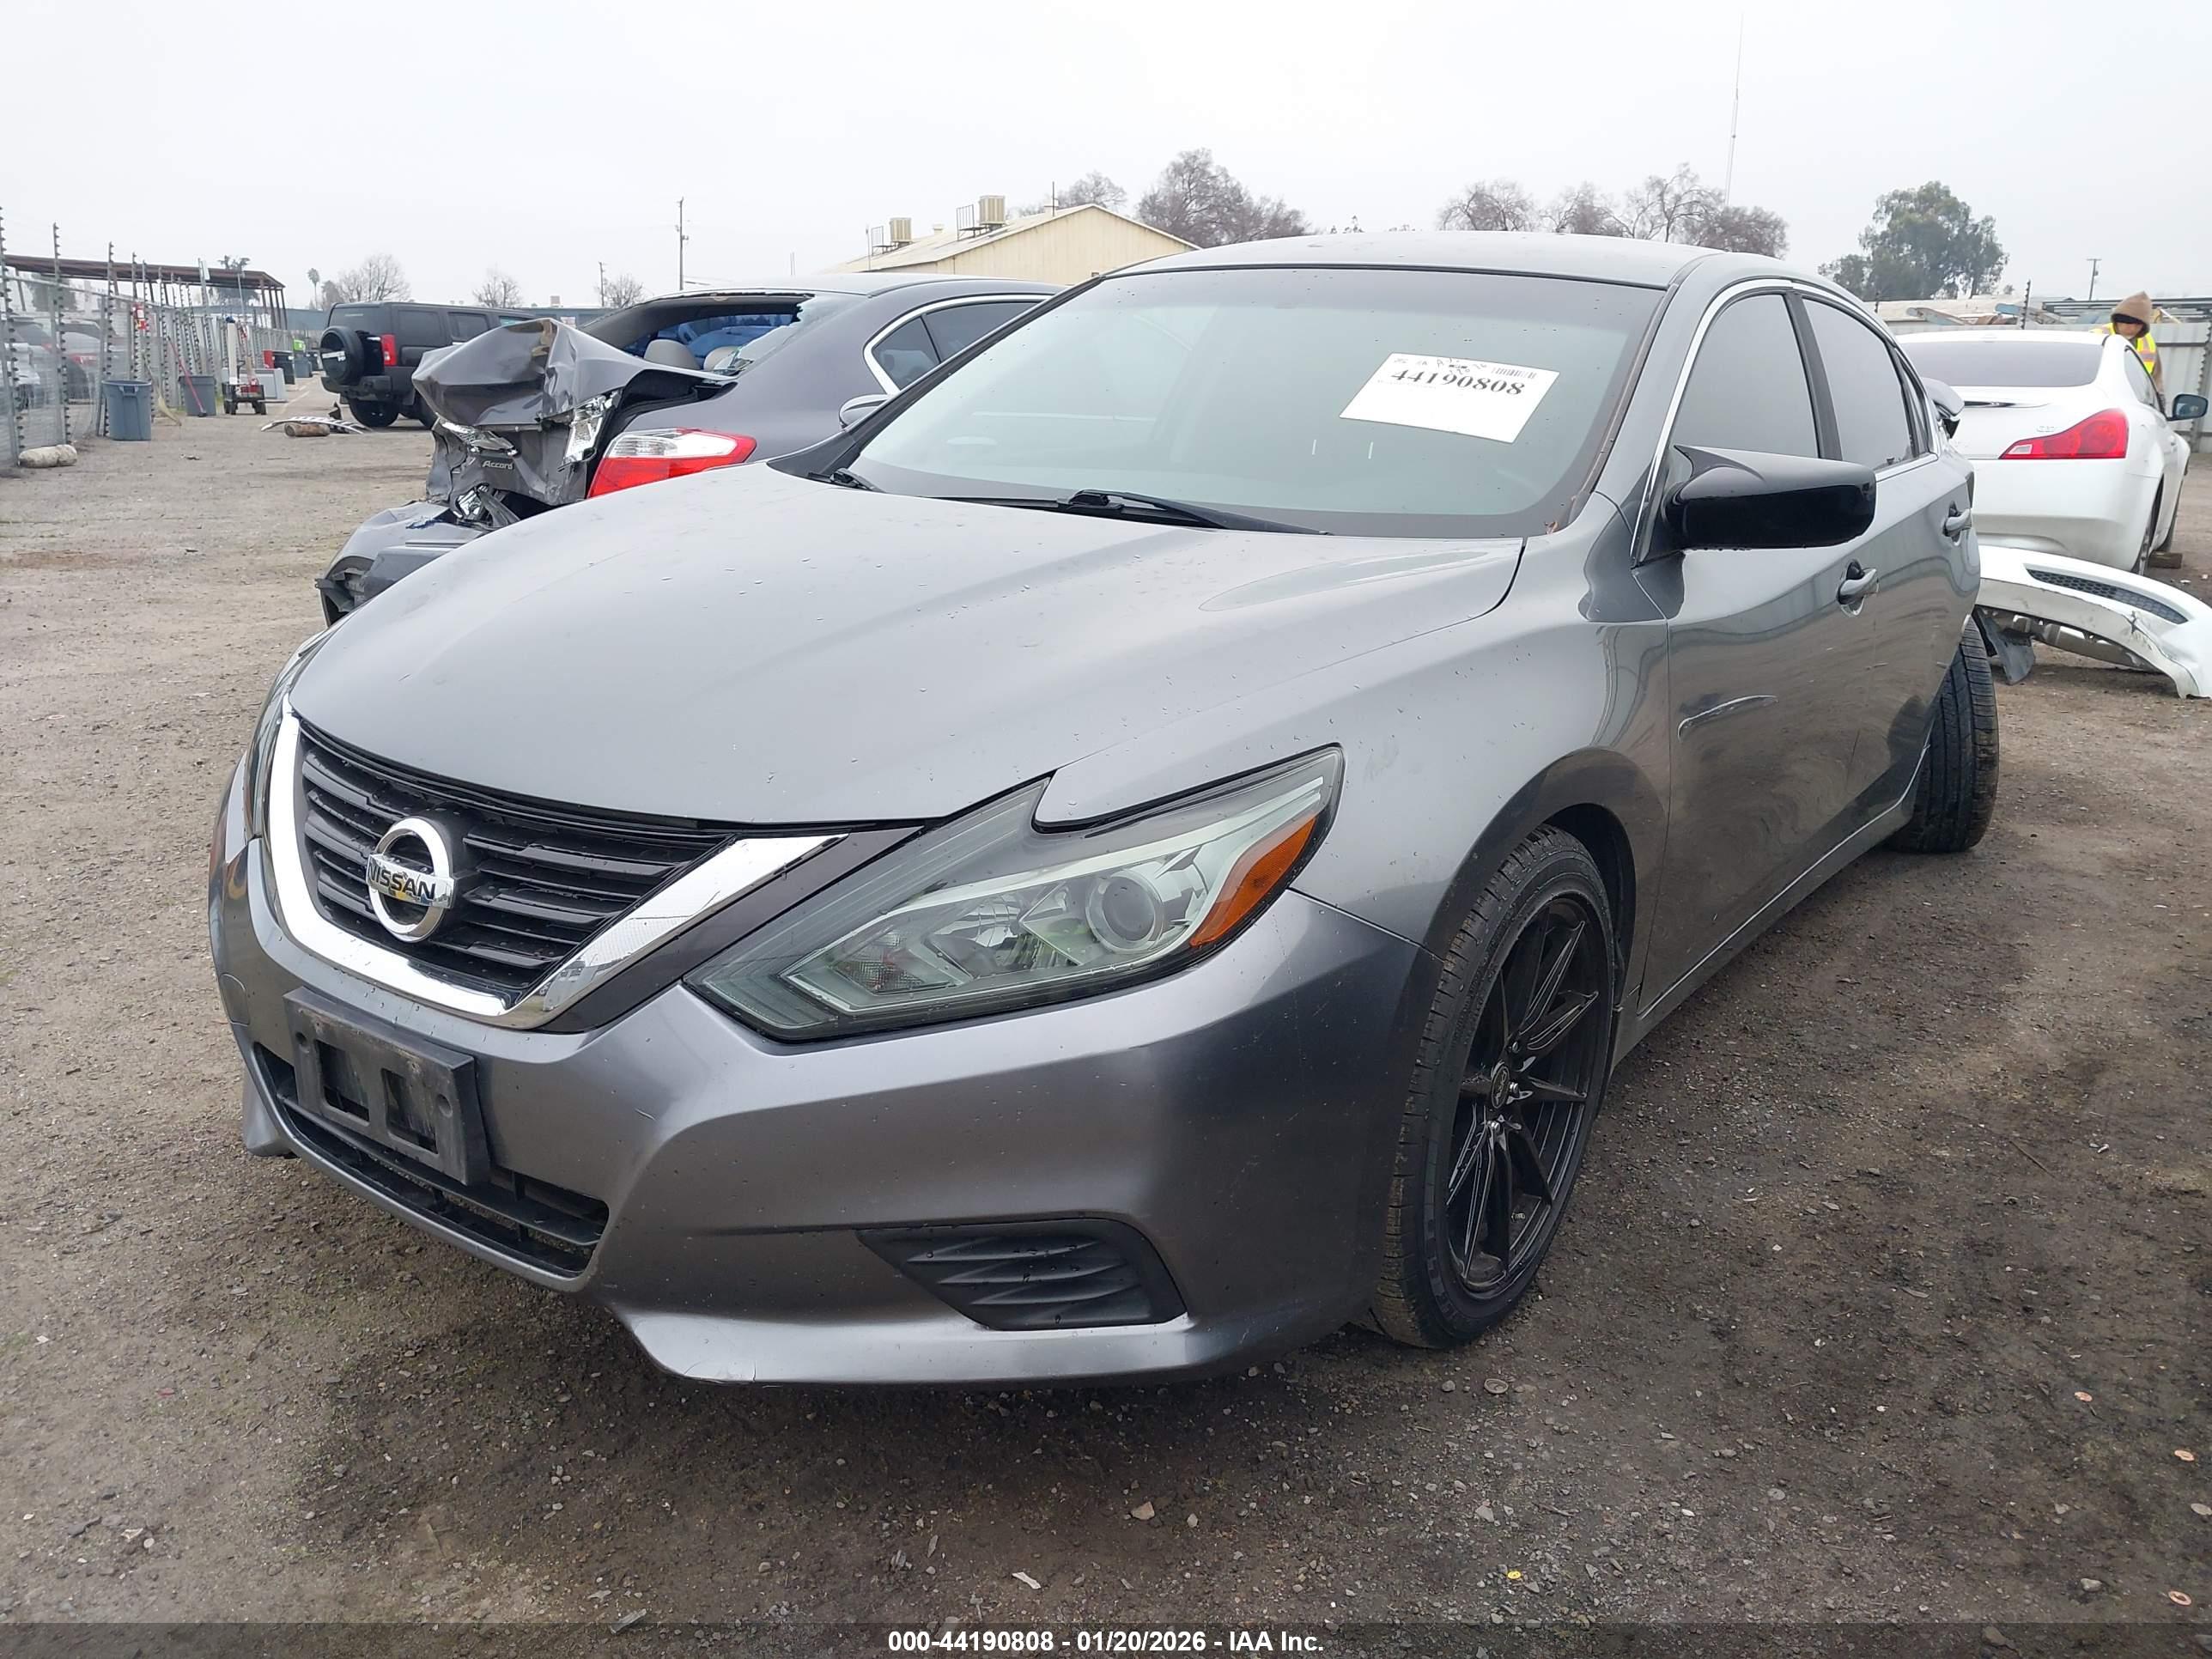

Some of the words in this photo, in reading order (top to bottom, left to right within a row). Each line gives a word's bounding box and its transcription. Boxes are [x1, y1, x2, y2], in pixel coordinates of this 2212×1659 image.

[1391, 369, 1525, 395] 44190808
[483, 460, 514, 470] Accord
[368, 861, 436, 900] NISSAN
